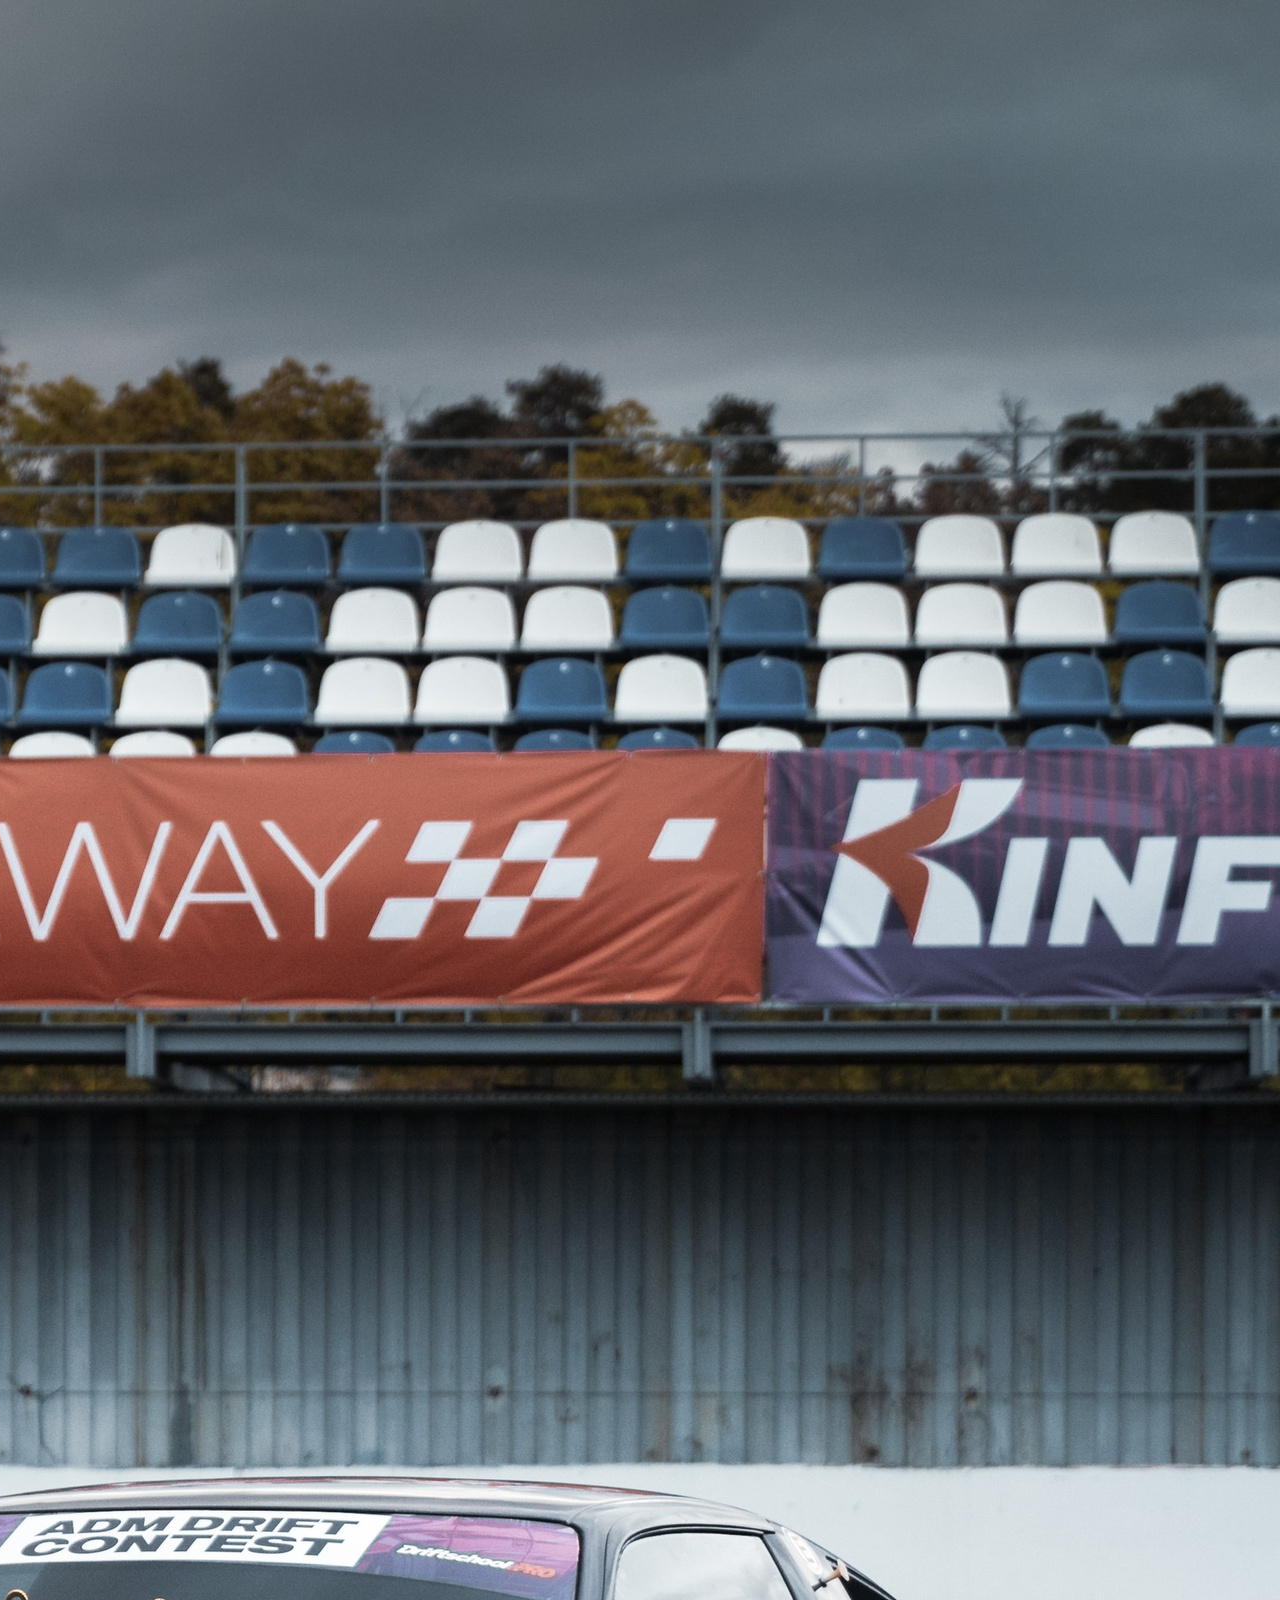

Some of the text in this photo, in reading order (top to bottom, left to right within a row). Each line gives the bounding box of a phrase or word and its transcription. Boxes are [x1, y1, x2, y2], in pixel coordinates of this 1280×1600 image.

[35, 1516, 360, 1536] ADM DRIFT
[20, 1534, 345, 1557] CONTEST
